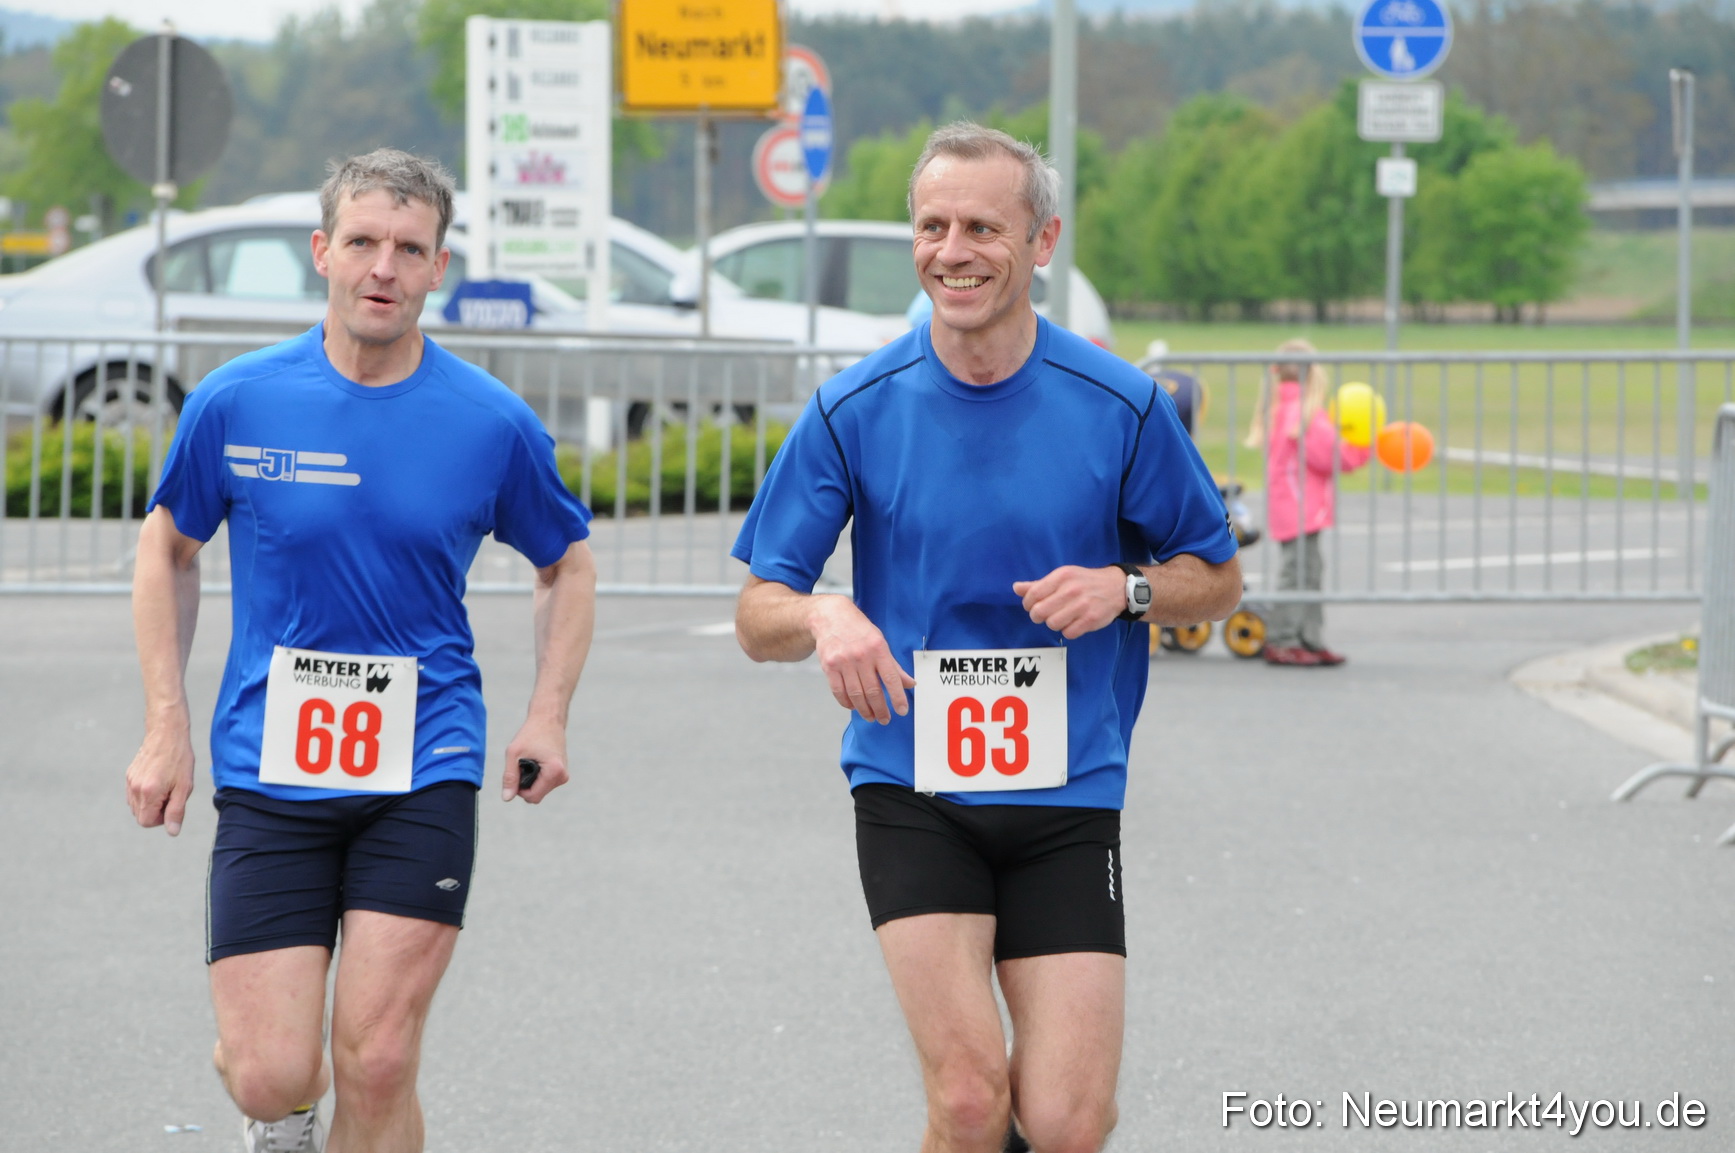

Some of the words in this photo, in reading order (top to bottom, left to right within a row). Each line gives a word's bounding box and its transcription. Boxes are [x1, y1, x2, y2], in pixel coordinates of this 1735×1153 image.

[634, 31, 766, 59] Neumarkt
[293, 657, 361, 677] MEYER
[939, 657, 1008, 673] MEYER
[293, 673, 361, 690] WERBUNG
[939, 674, 1009, 686] WERBUNG
[295, 698, 382, 777] 68
[947, 695, 1030, 777] 63
